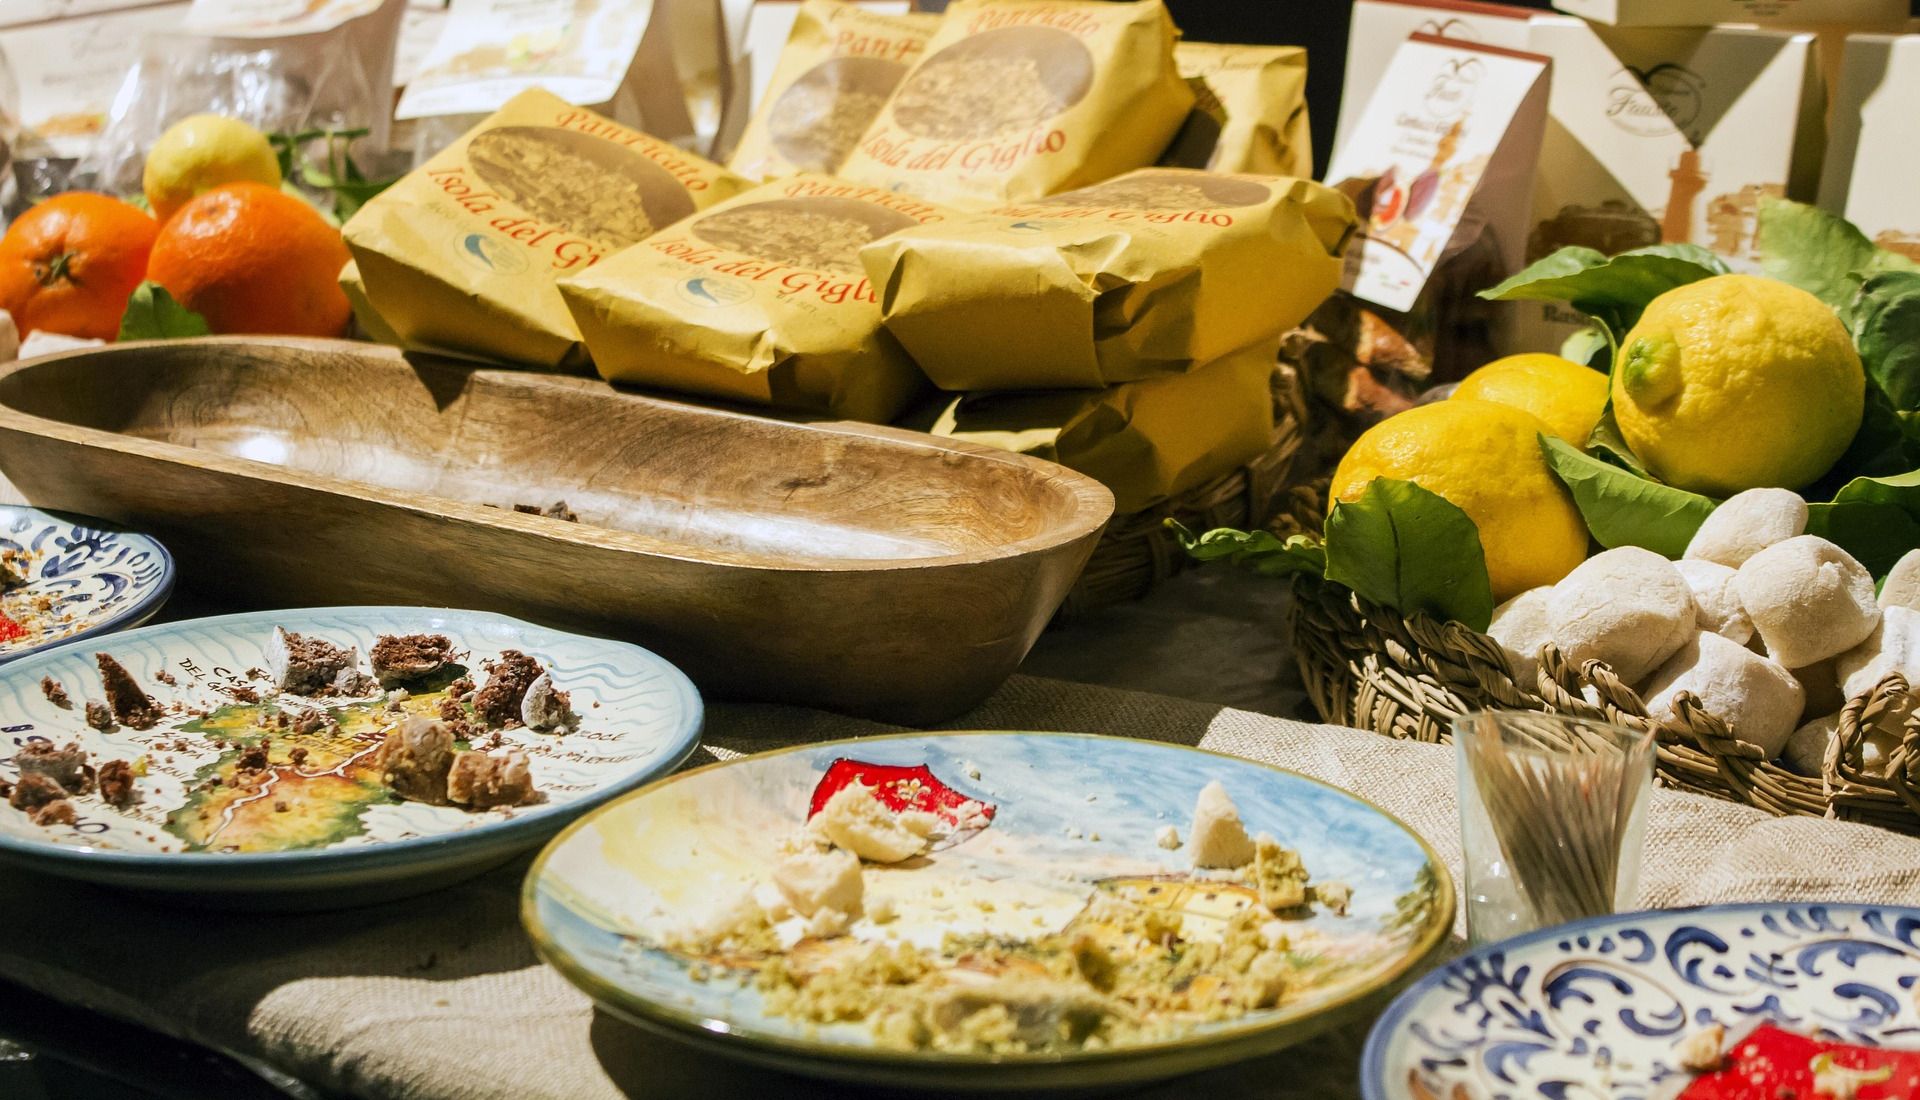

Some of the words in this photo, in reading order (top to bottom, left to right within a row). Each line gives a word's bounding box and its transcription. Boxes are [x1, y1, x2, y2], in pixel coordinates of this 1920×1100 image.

[859, 127, 911, 168] Isola
[906, 140, 963, 171] del
[959, 128, 1066, 172] Giglio
[427, 166, 500, 215] Isola
[489, 214, 565, 250] del
[1108, 207, 1234, 228] Giglio
[650, 237, 722, 266] Isola
[712, 257, 788, 282] del
[178, 657, 208, 682] DEL
